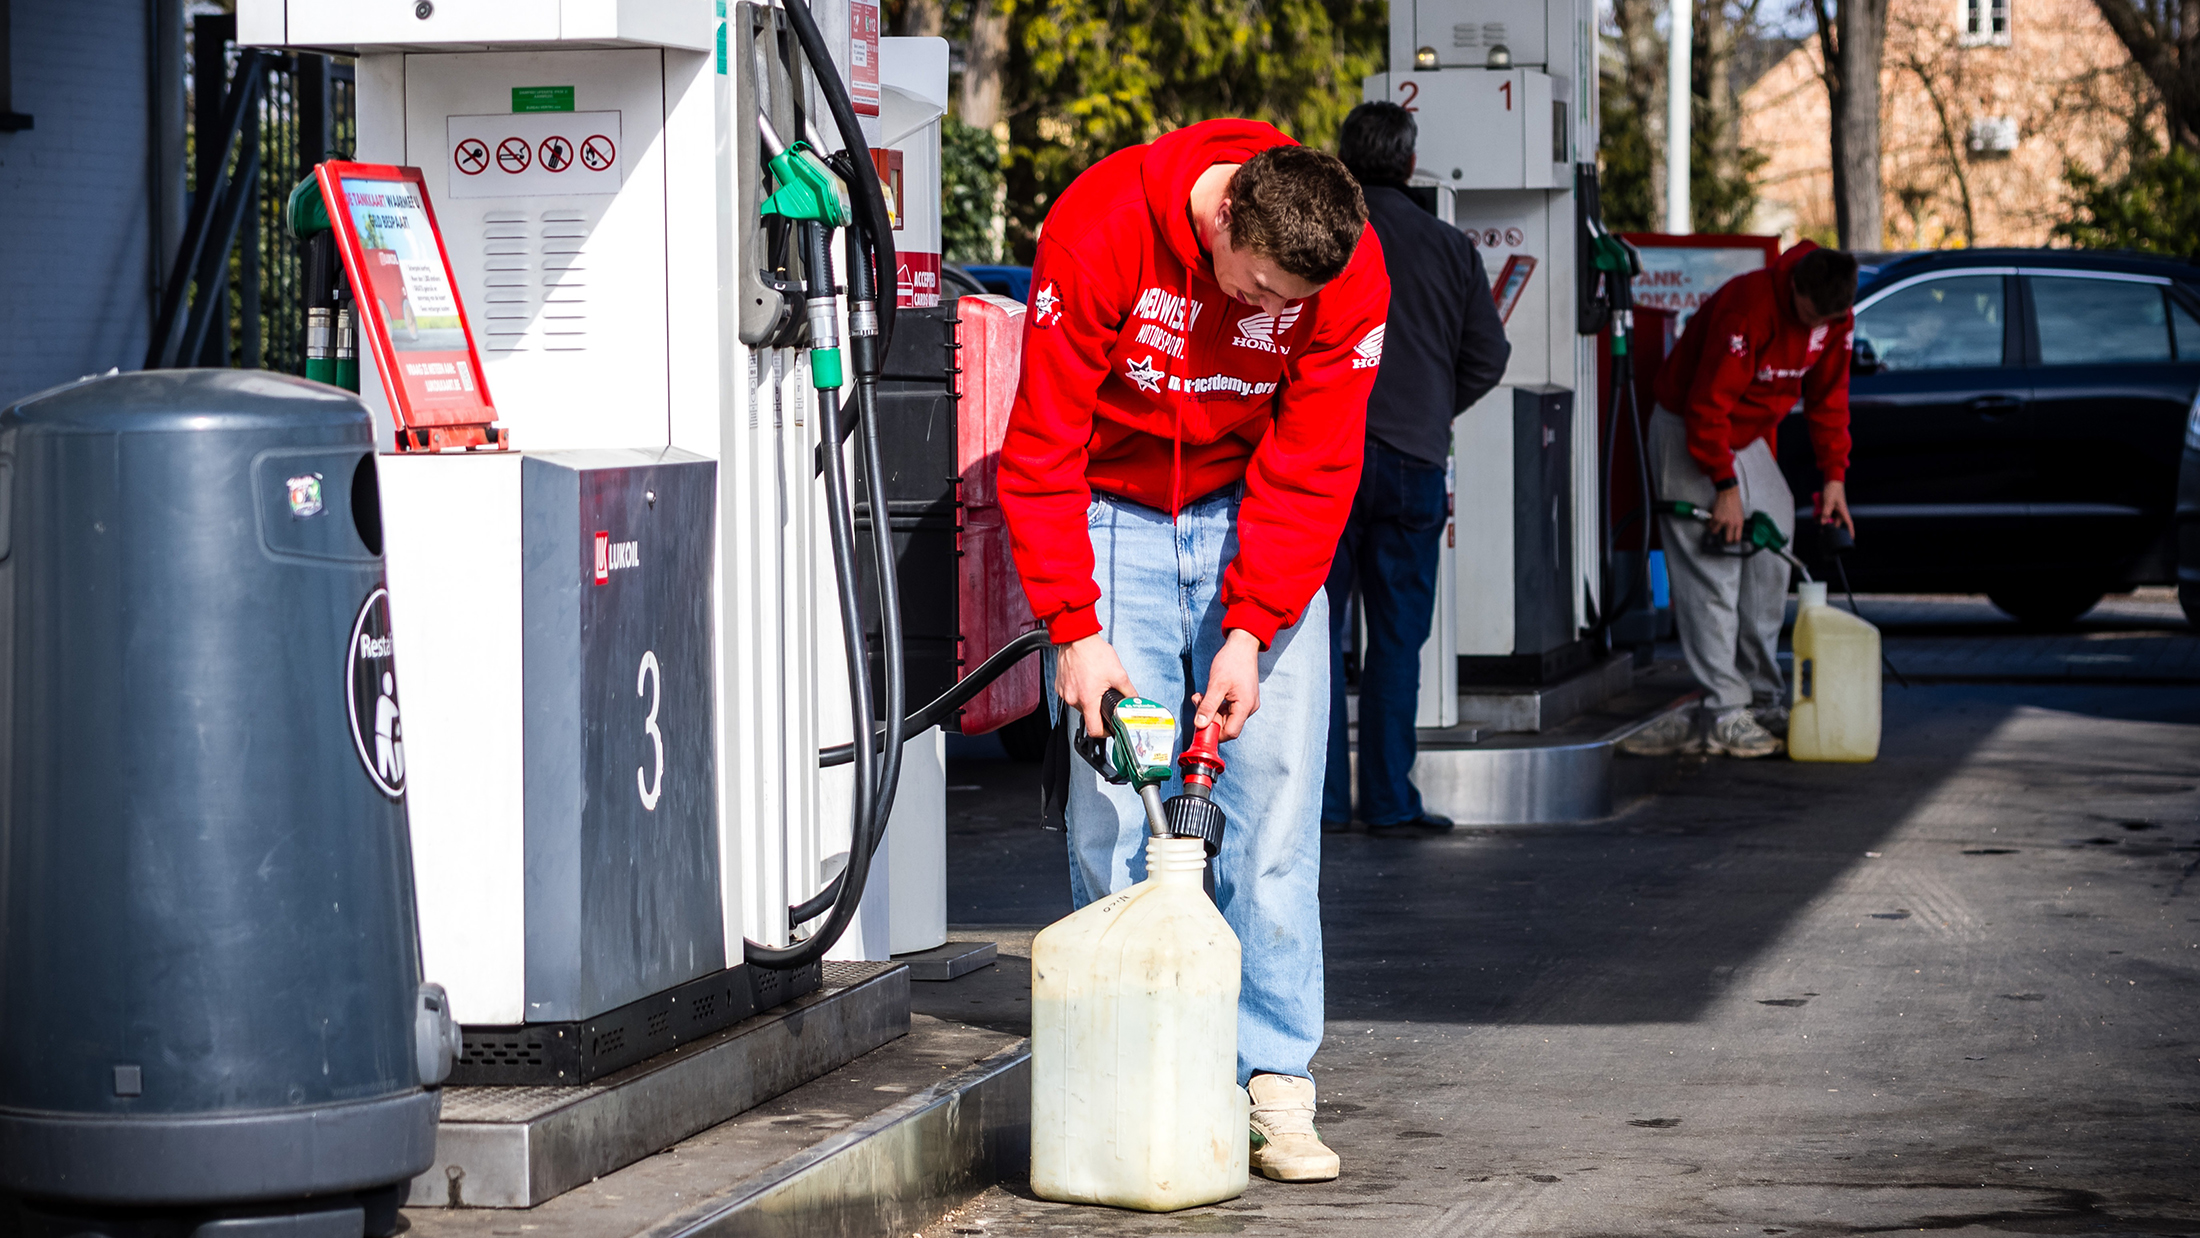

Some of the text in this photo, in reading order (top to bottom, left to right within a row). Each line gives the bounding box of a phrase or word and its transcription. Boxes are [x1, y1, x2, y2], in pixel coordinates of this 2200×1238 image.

[1399, 81, 1419, 112] 2
[1499, 80, 1513, 111] 1
[352, 192, 386, 207] TANKKAART
[382, 214, 410, 229] BESPAART
[1632, 270, 1692, 287] ANK-
[1132, 288, 1203, 332] MEUWISN
[1352, 356, 1380, 369] HO
[609, 541, 639, 570] LUKOIL
[638, 650, 664, 810] 3
